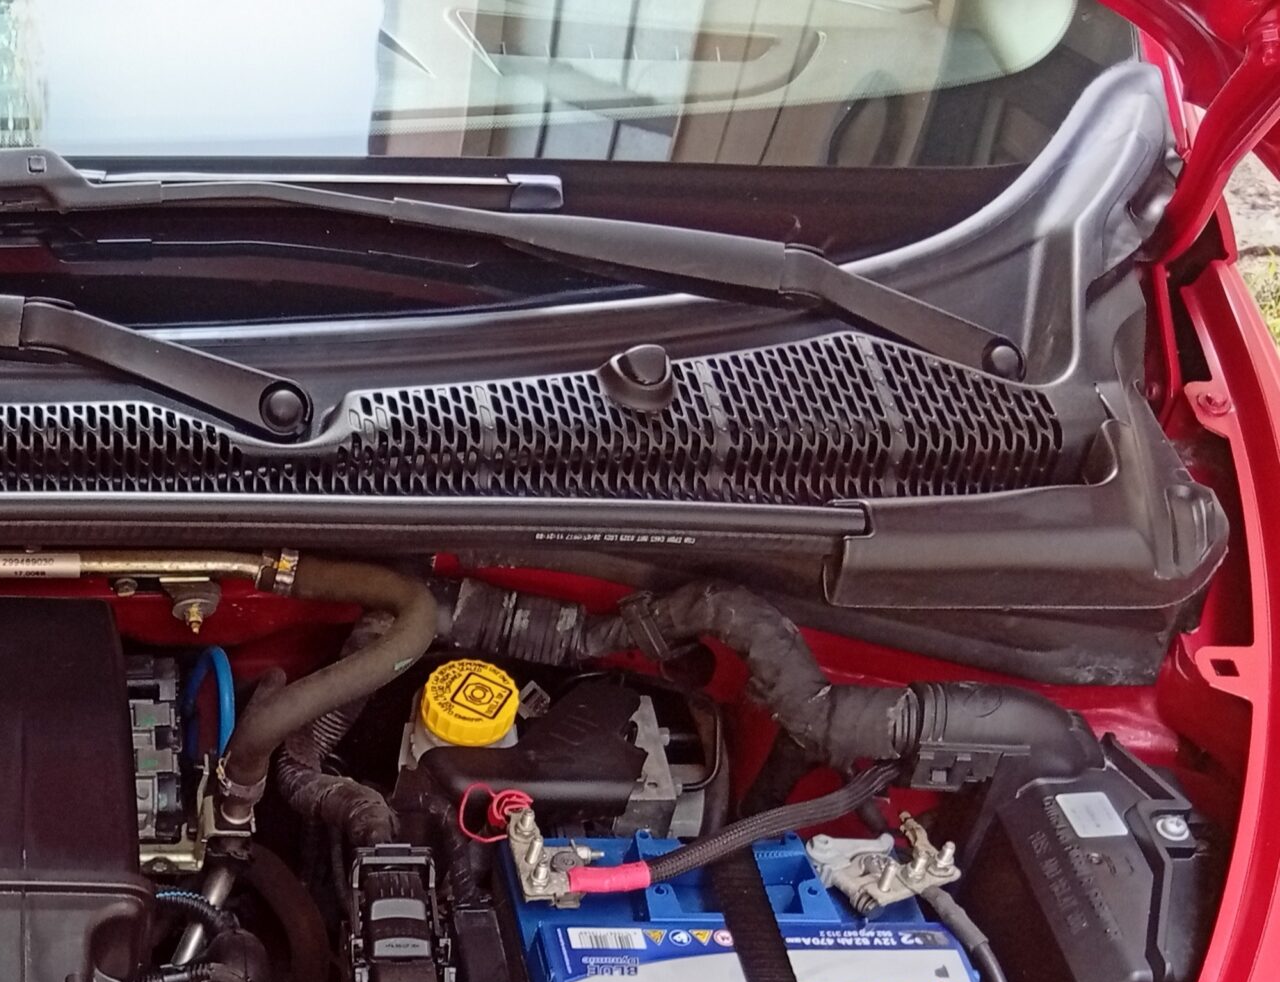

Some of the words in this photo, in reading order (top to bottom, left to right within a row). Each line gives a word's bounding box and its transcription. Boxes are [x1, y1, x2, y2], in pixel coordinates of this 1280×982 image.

[874, 937, 897, 946] 12V
[582, 956, 640, 966] Dynamic
[586, 964, 638, 976] BLUE
